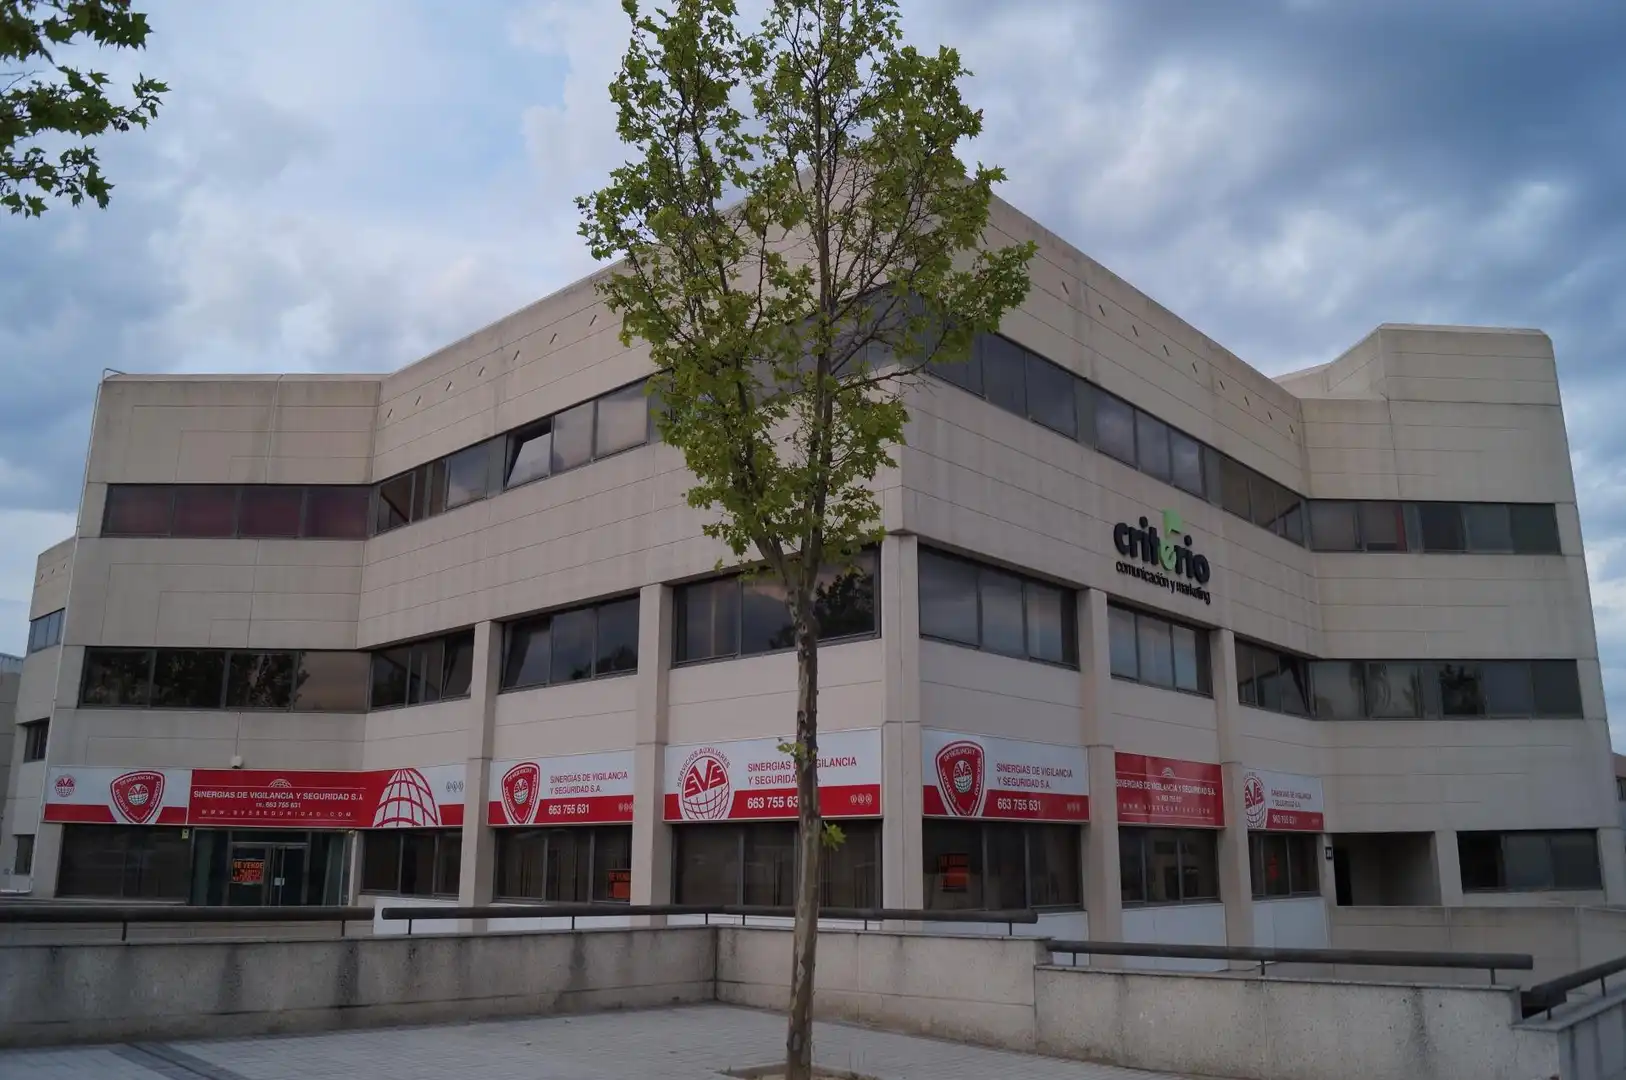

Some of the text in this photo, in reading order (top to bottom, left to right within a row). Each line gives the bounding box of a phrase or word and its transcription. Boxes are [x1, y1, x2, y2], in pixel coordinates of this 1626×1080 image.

[1113, 509, 1210, 583] criterio
[677, 746, 731, 787] SERVICIOS AUXILIARES
[748, 760, 791, 772] SINERGIAS
[816, 756, 857, 769] GILANCIA
[996, 763, 1073, 778] SINERGIAS DE VIGILANCIA
[549, 771, 628, 784] SINERGIAS DE VIGILANCIA
[748, 774, 797, 786] Y SEGURIDA
[997, 777, 1002, 786] Y
[1003, 777, 1040, 788] SEGURIDAD
[194, 790, 235, 798] SINERGIAS
[237, 791, 248, 799] DE
[249, 791, 294, 799] VIGILANCIA
[296, 792, 302, 800] Y
[303, 792, 349, 800] SEGURIDAD
[549, 786, 554, 794] Y
[555, 785, 589, 795] SEGURIDAD
[747, 795, 799, 809] 663 755 63
[997, 798, 1042, 811] 663 755 631
[548, 803, 590, 815] 663 755 631
